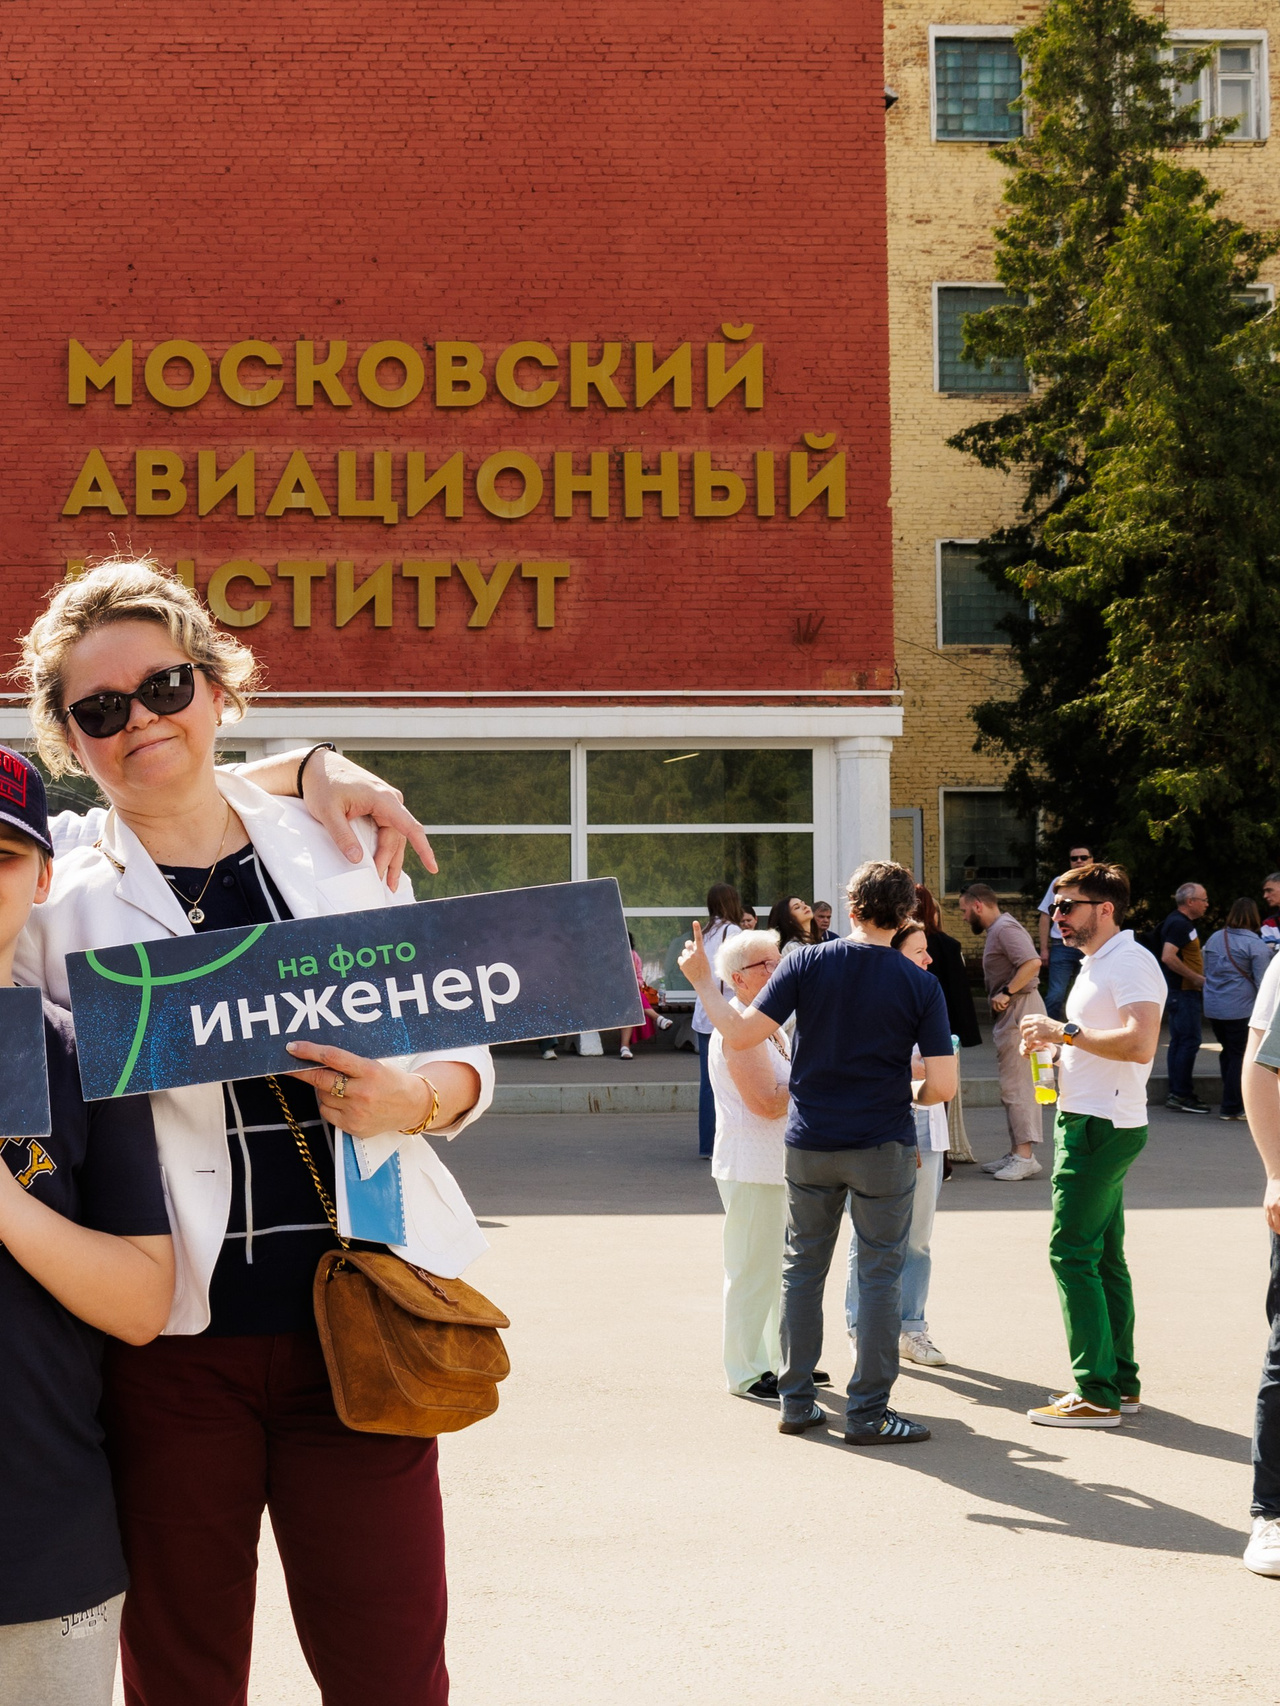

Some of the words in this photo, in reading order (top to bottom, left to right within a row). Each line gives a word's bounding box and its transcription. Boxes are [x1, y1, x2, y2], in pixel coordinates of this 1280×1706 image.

[68, 322, 764, 408] МОСКОВСКИЙ
[62, 432, 846, 524] АВИАЦИОННЫЙ
[67, 558, 570, 628] СТИТУТ
[277, 955, 320, 980] на
[328, 942, 417, 978] фото
[189, 962, 521, 1047] инженер
